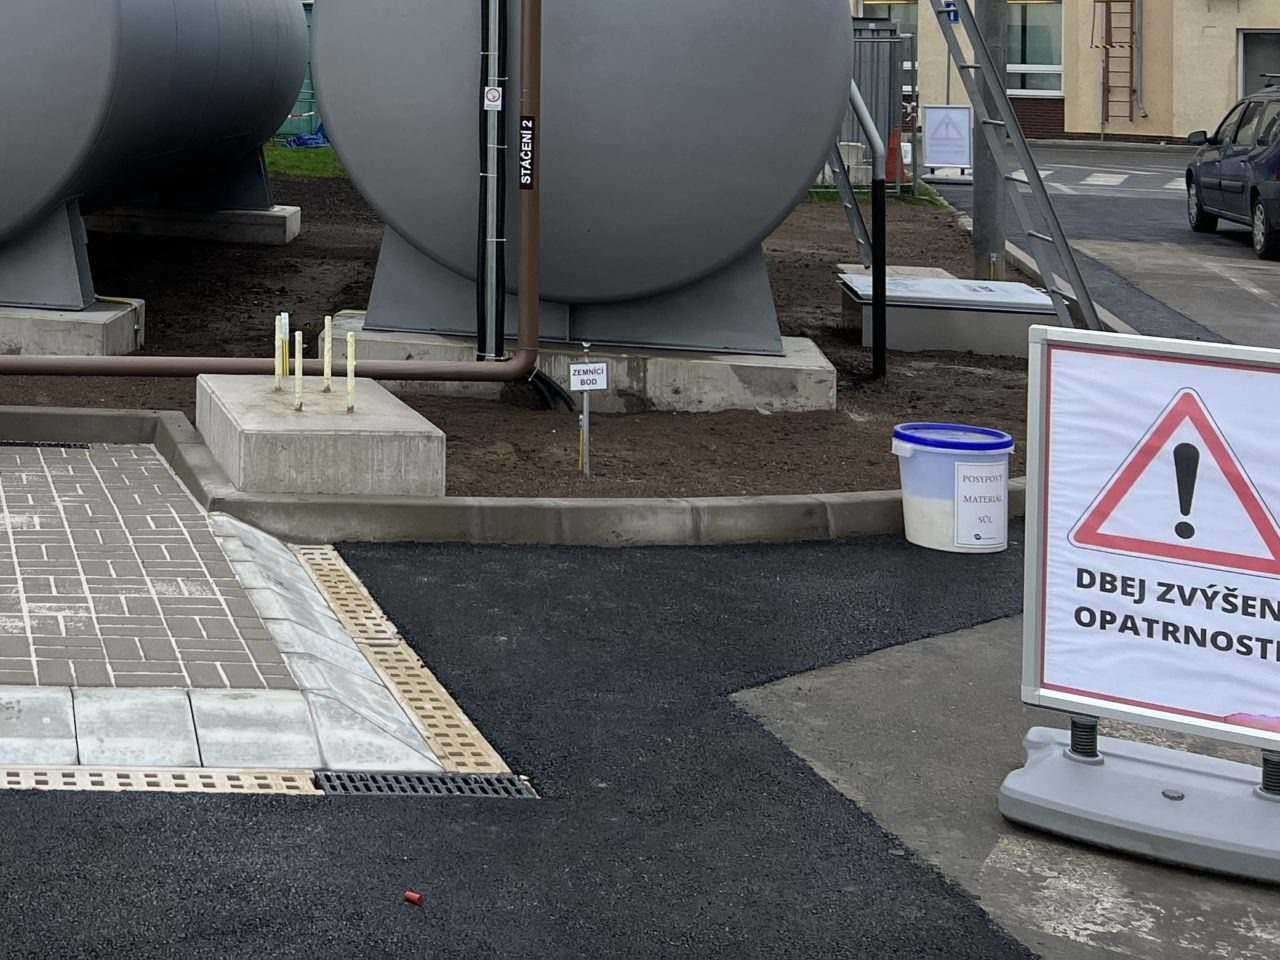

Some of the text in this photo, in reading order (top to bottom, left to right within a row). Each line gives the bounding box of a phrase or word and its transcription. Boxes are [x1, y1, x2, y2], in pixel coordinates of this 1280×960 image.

[520, 120, 533, 184] STÁČENÍ 2
[1076, 567, 1280, 622] DBEJ ZVÝŠEN
